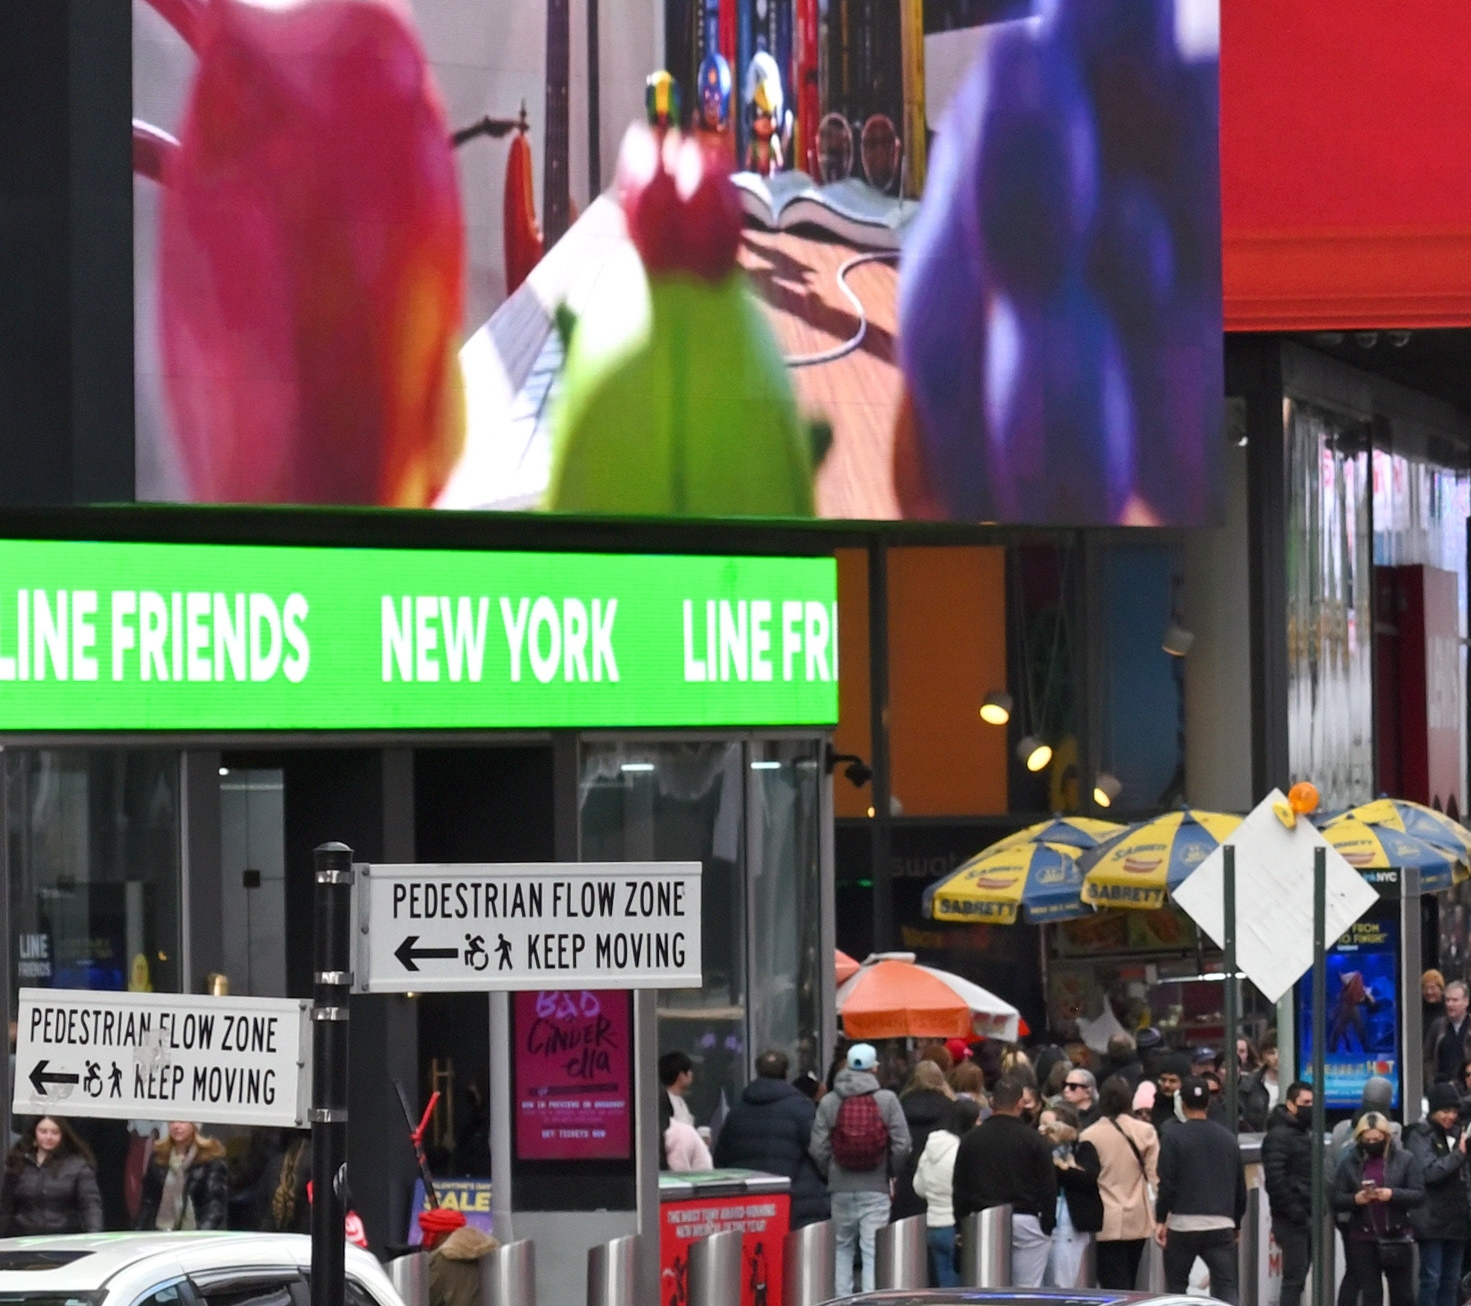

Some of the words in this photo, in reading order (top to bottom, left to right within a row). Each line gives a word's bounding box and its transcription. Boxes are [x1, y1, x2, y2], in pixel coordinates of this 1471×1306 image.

[110, 591, 310, 684] FRIENDS
[380, 594, 489, 683] NEW
[500, 596, 619, 684] YORK
[683, 598, 774, 683] LINE
[393, 883, 543, 920] PEDESTRIAN
[551, 883, 615, 919] FLOW
[624, 882, 685, 918] ZONE
[939, 900, 1016, 917] SABRETT
[1089, 883, 1163, 904] SABRETT
[19, 933, 48, 959] LINE
[527, 933, 586, 970] KEEP
[595, 933, 686, 970] MOVING
[30, 1007, 152, 1048] PEDESTRIAN
[159, 1012, 215, 1052] FLOW
[222, 1015, 279, 1054] ZONE
[133, 1062, 185, 1103] KEEP
[192, 1066, 278, 1106] MOVING
